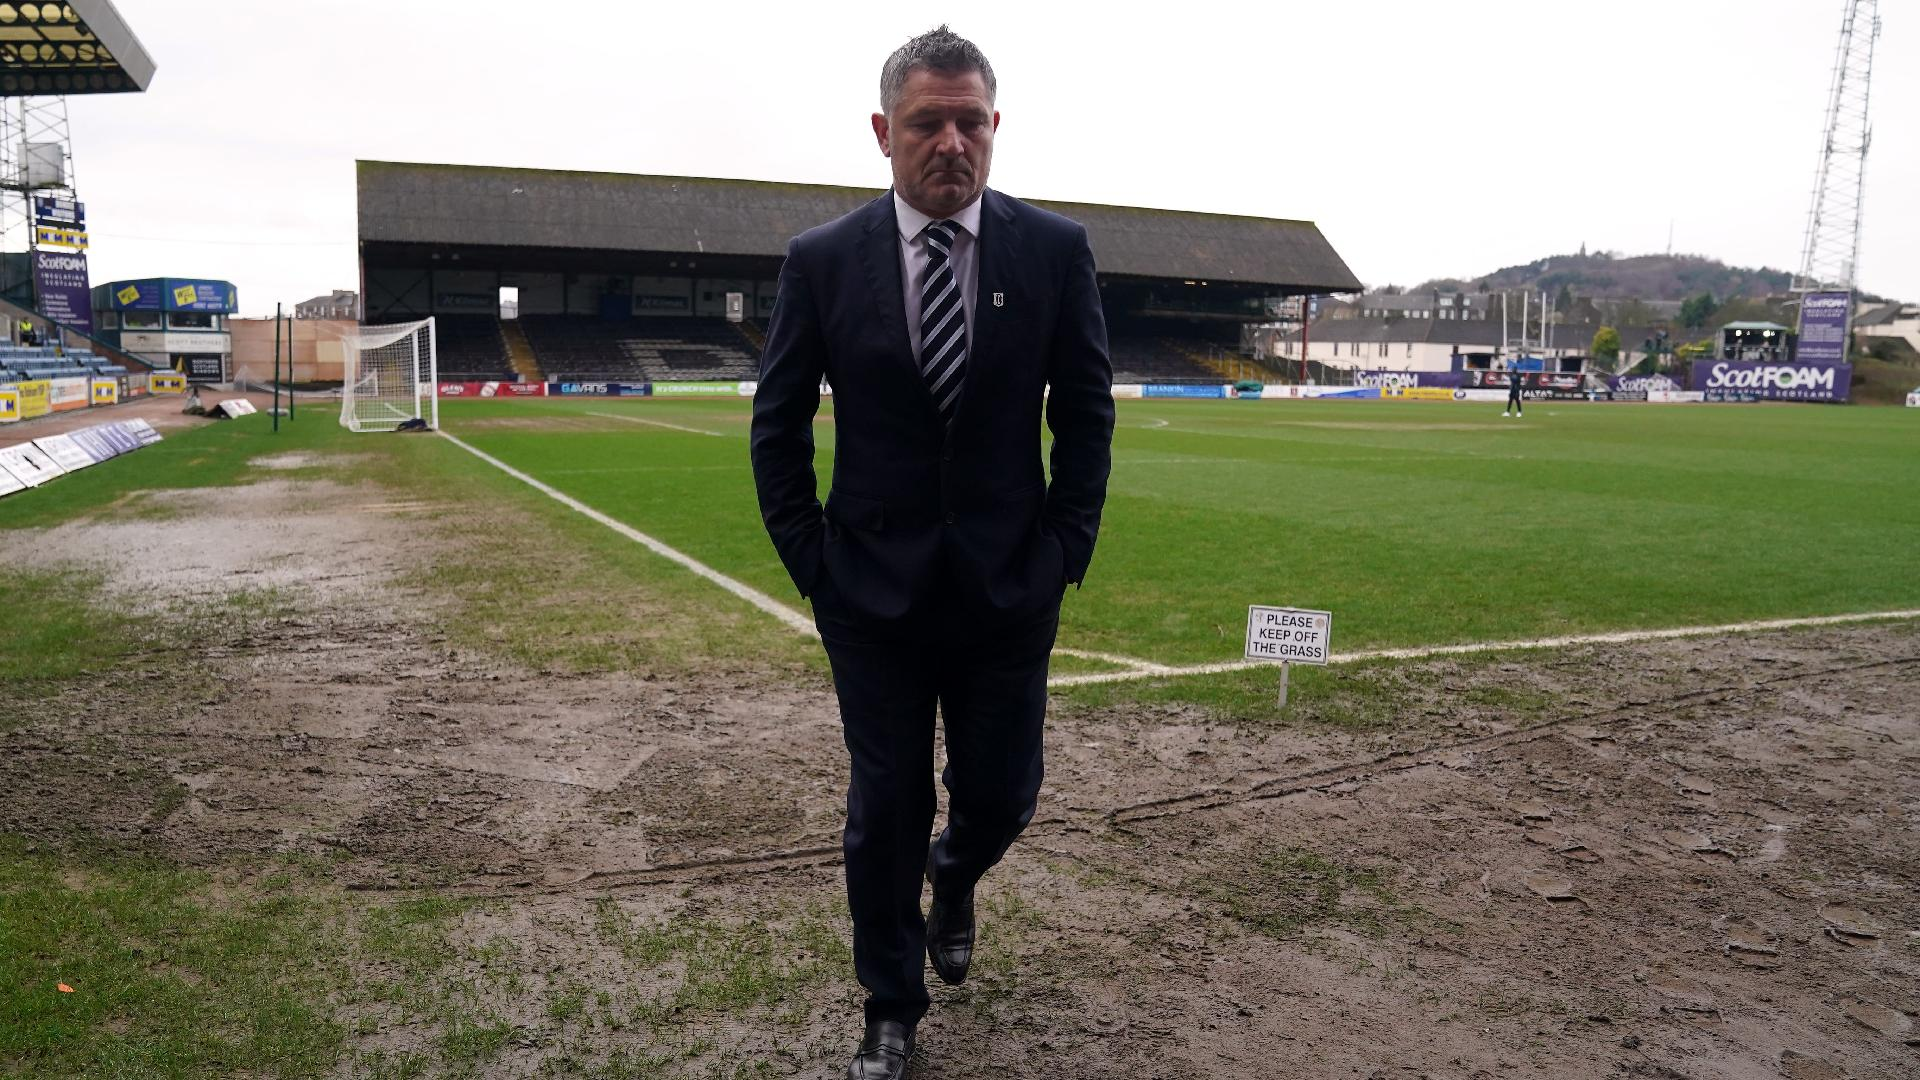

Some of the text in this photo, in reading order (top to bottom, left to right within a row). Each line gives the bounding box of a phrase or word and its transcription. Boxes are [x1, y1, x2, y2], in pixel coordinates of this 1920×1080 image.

[1357, 370, 1418, 388] ScotFOAM
[1706, 362, 1835, 390] ScotFOAM
[1776, 390, 1833, 398] SCOTLAND
[1267, 614, 1313, 628] PLEASE
[1259, 628, 1319, 643] KEEP OFF
[1253, 642, 1322, 658] THE GRASS
